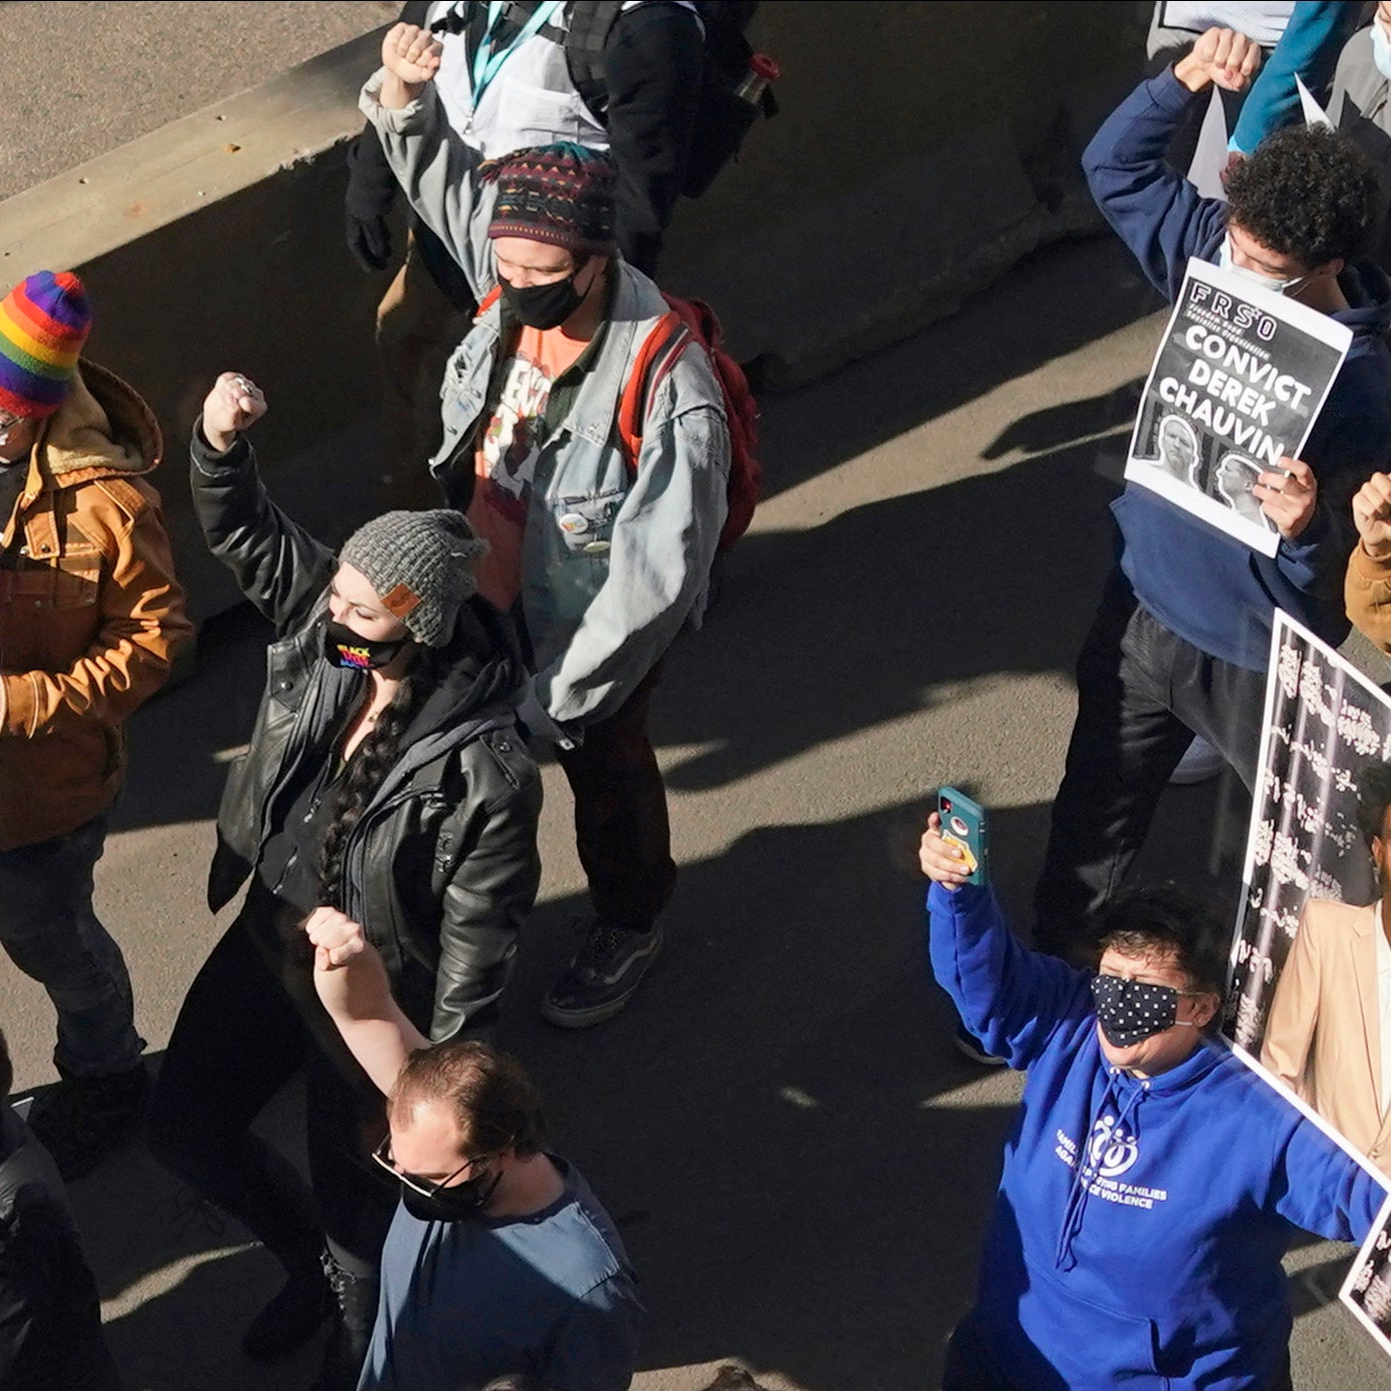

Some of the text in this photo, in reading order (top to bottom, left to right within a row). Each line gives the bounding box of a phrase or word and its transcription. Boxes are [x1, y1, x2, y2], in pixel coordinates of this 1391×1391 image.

[1190, 284, 1277, 341] FRSO
[1186, 325, 1311, 410] CONVICT
[1188, 359, 1276, 427] DEREK
[1159, 377, 1285, 466] CHAUVIN
[1101, 1189, 1153, 1210] VIOLENCE
[1119, 1183, 1167, 1200] FAMILIES
